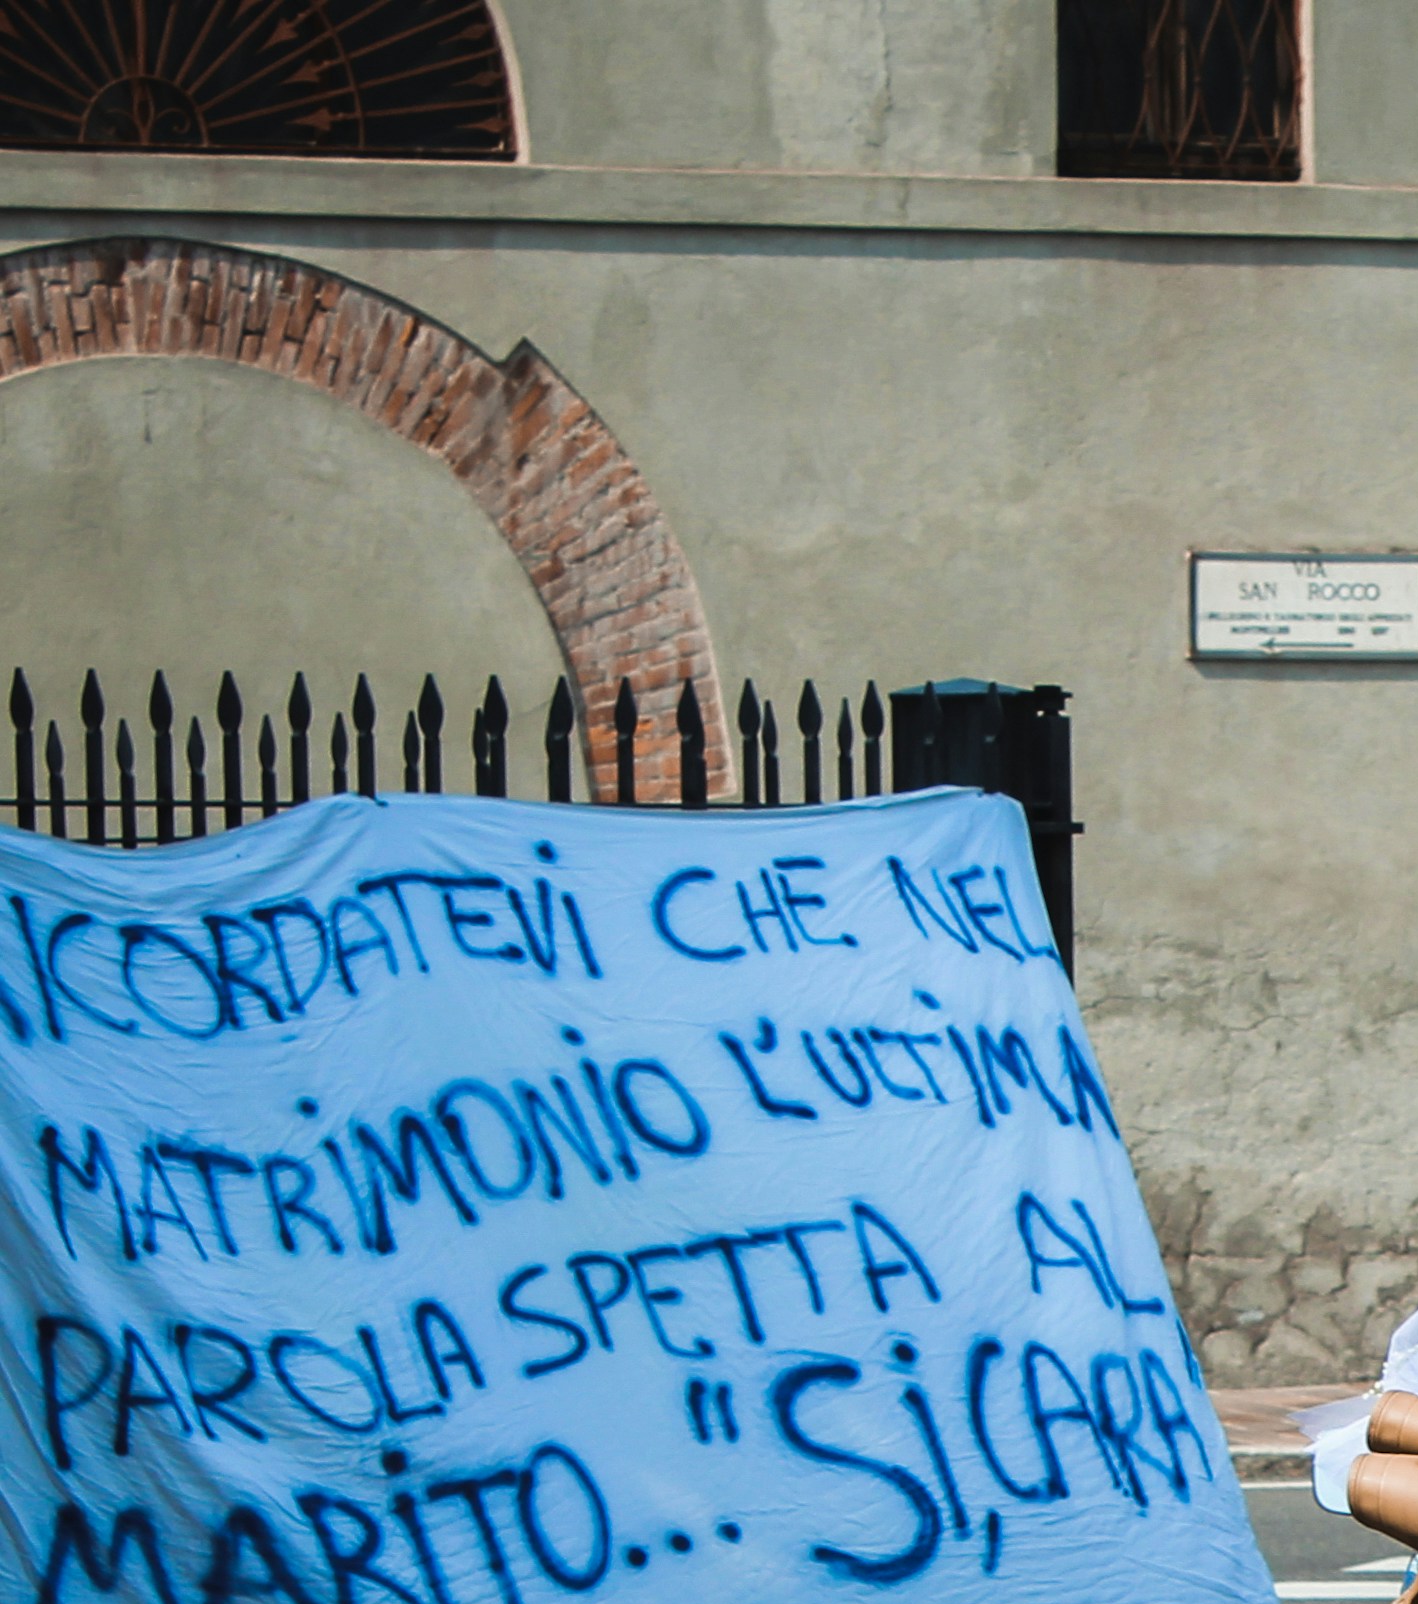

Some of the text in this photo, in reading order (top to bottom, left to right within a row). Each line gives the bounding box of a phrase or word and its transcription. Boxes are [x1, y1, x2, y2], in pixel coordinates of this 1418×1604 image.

[1238, 581, 1381, 601] SAN ROCCO
[1292, 561, 1327, 578] VIA
[650, 855, 860, 963] CHE
[886, 854, 1064, 965] NEL
[36, 1191, 1166, 1472] PAROLA SPETTA AL
